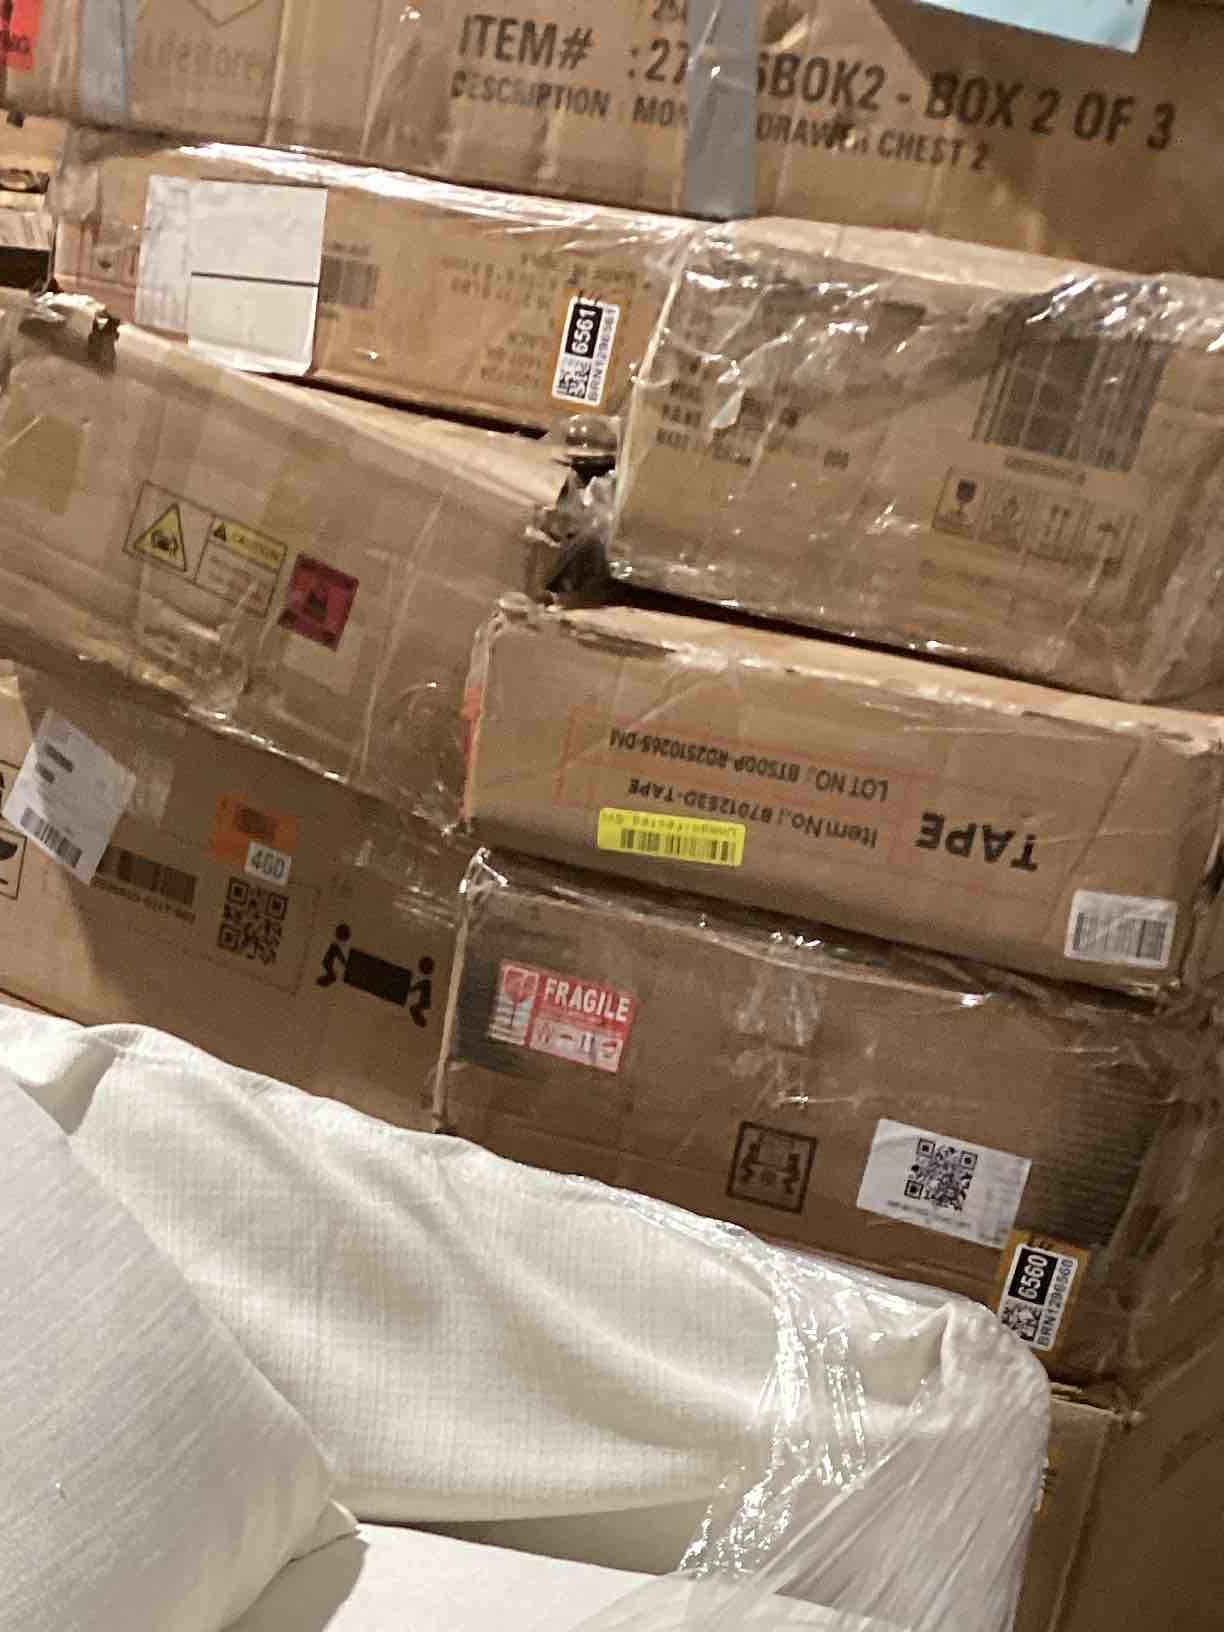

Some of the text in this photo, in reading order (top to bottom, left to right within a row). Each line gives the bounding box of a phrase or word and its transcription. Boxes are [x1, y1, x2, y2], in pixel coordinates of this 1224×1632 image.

[459, 14, 593, 70] ITEM#
[926, 70, 1024, 130] BOX
[1030, 89, 1061, 136] 2
[1073, 91, 1135, 144] OF
[1146, 102, 1176, 151] 3
[879, 131, 964, 167] CHEST
[970, 146, 991, 171] 2
[571, 308, 597, 355] 6561
[849, 772, 889, 802] LOT
[914, 810, 1040, 873] TAPE
[542, 976, 632, 1023] FRAGILE
[1017, 1253, 1049, 1300] 6560
